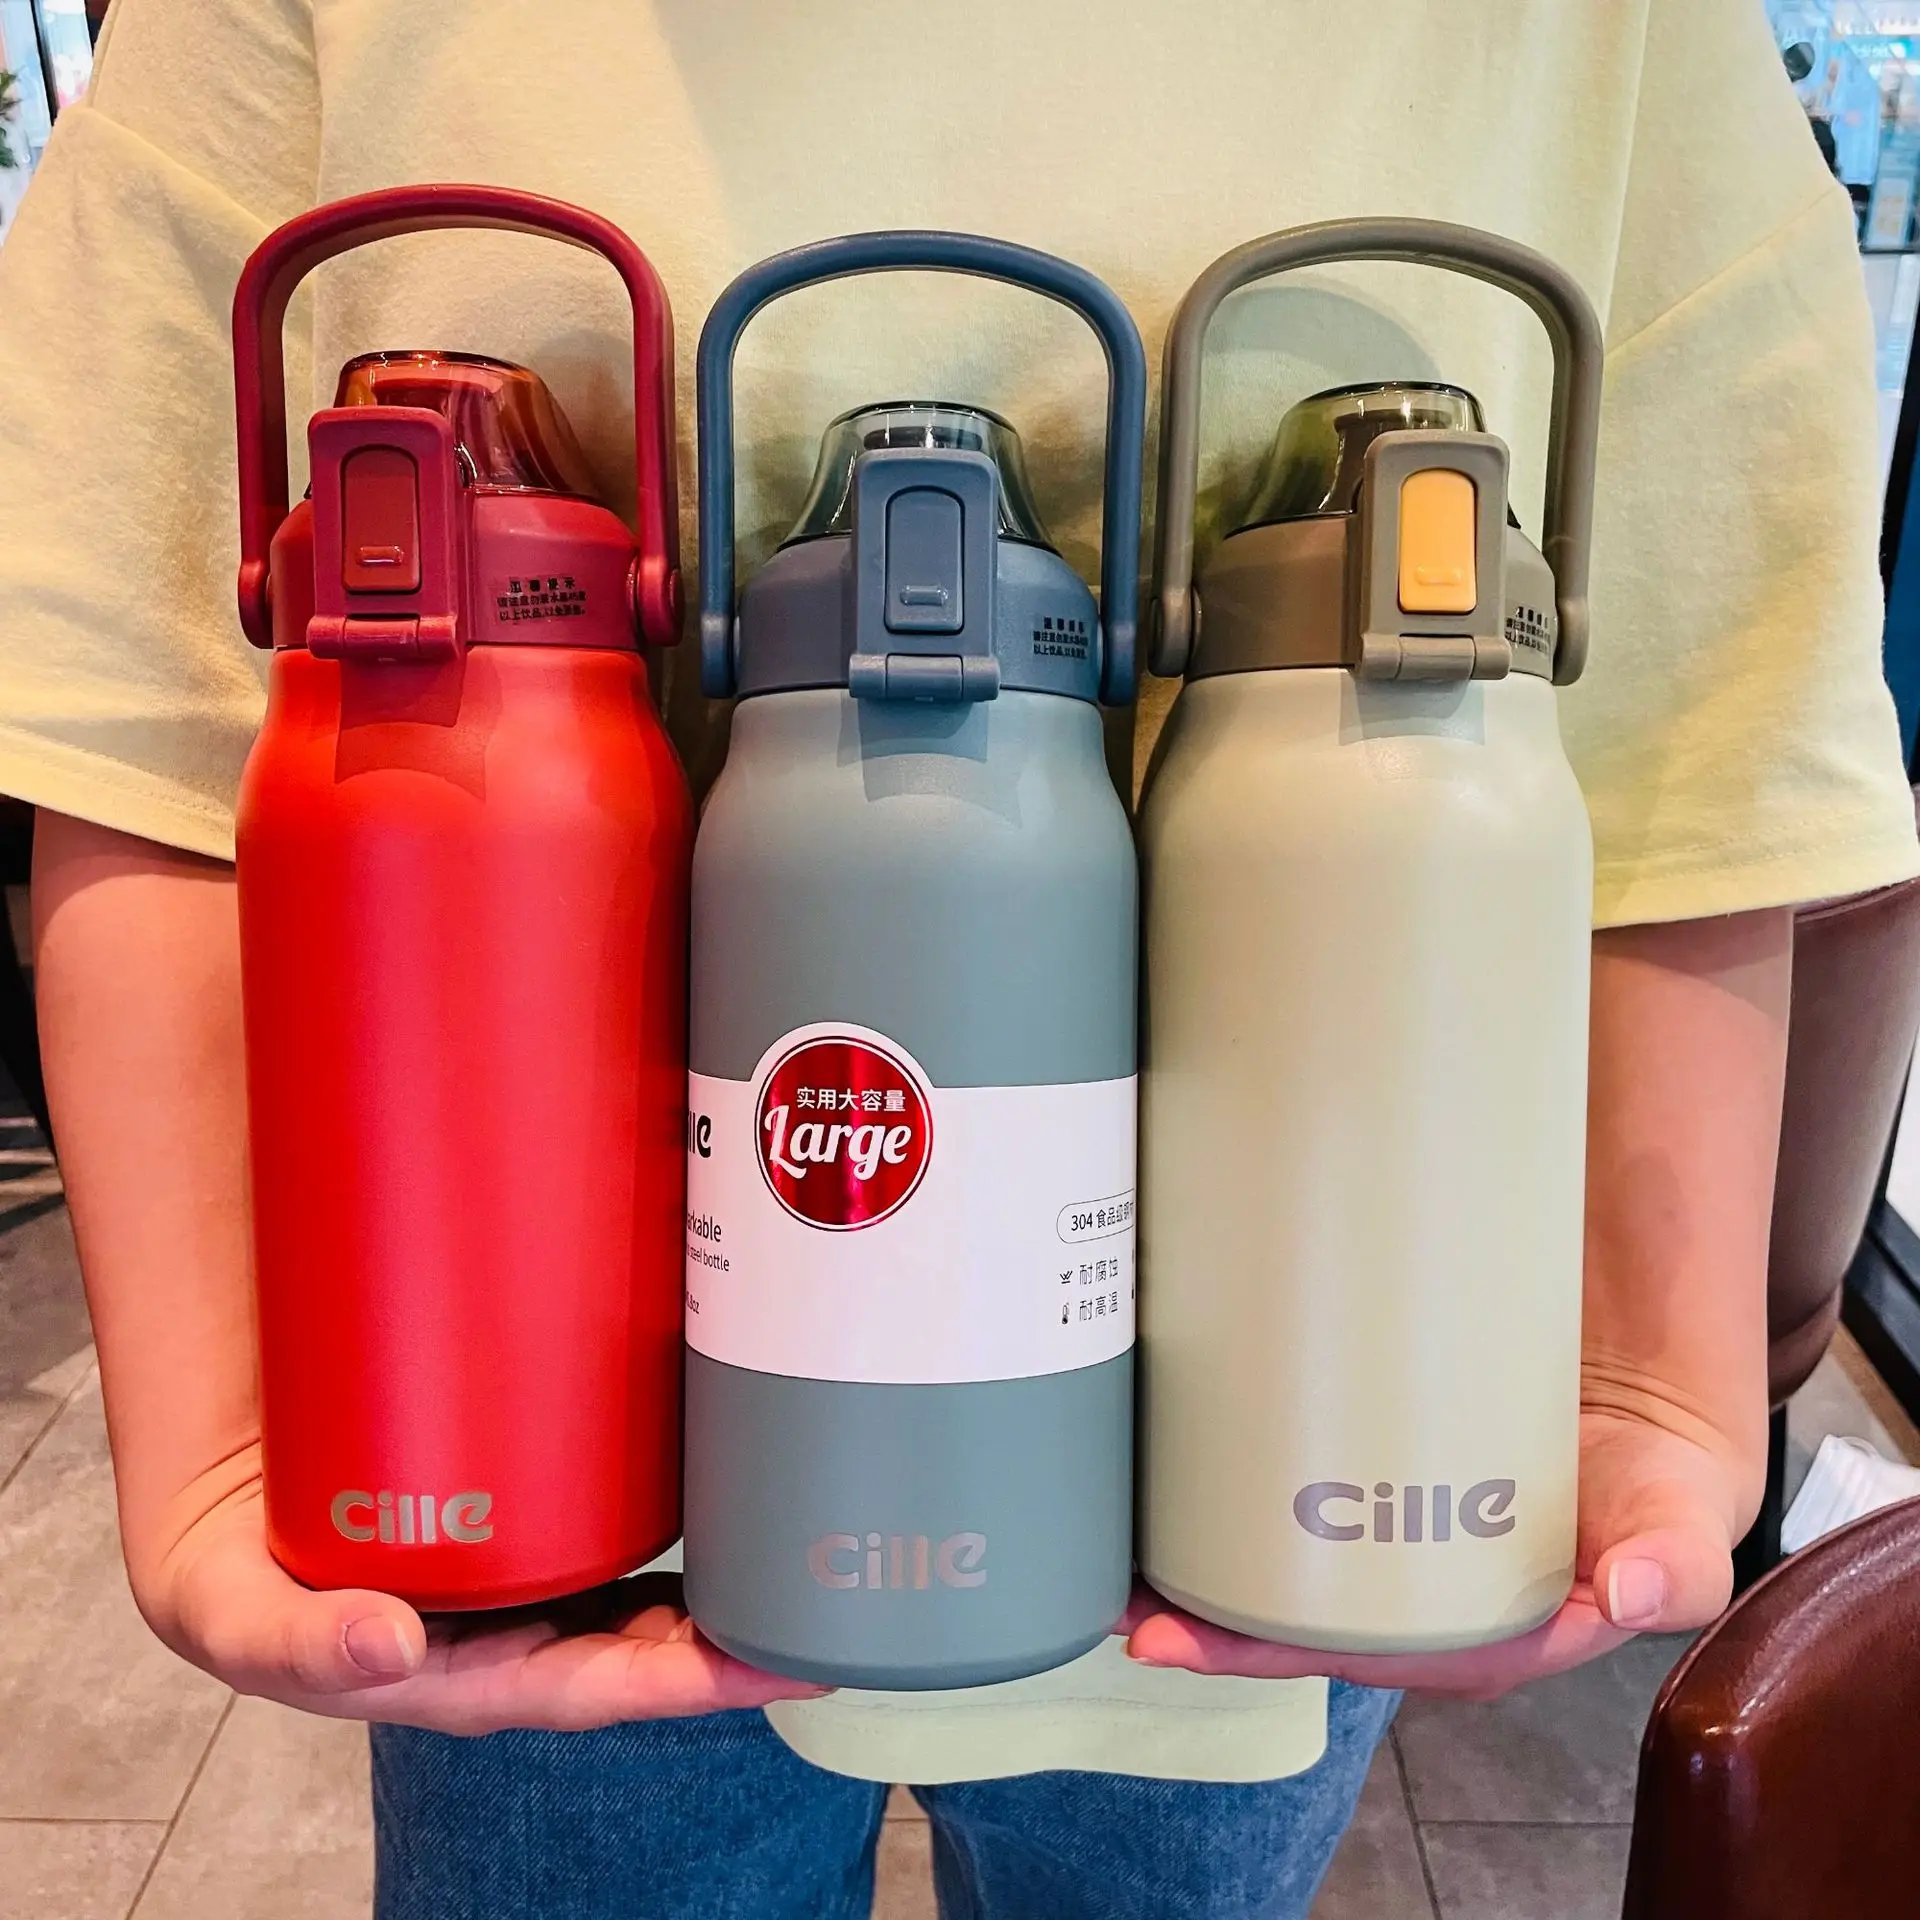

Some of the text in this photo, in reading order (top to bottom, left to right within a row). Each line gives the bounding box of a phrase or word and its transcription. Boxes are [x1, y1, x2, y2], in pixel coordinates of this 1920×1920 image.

[796, 1087, 906, 1112] 实用大容量
[764, 1105, 912, 1181] Large
[1071, 1212, 1093, 1231] 304
[703, 1248, 730, 1272] bottle
[1079, 1256, 1119, 1285] 耐腐蚀
[1079, 1291, 1119, 1322] 耐高温
[331, 1490, 494, 1544] Cille
[1293, 1479, 1516, 1542] Cille
[808, 1532, 988, 1590] Cille
